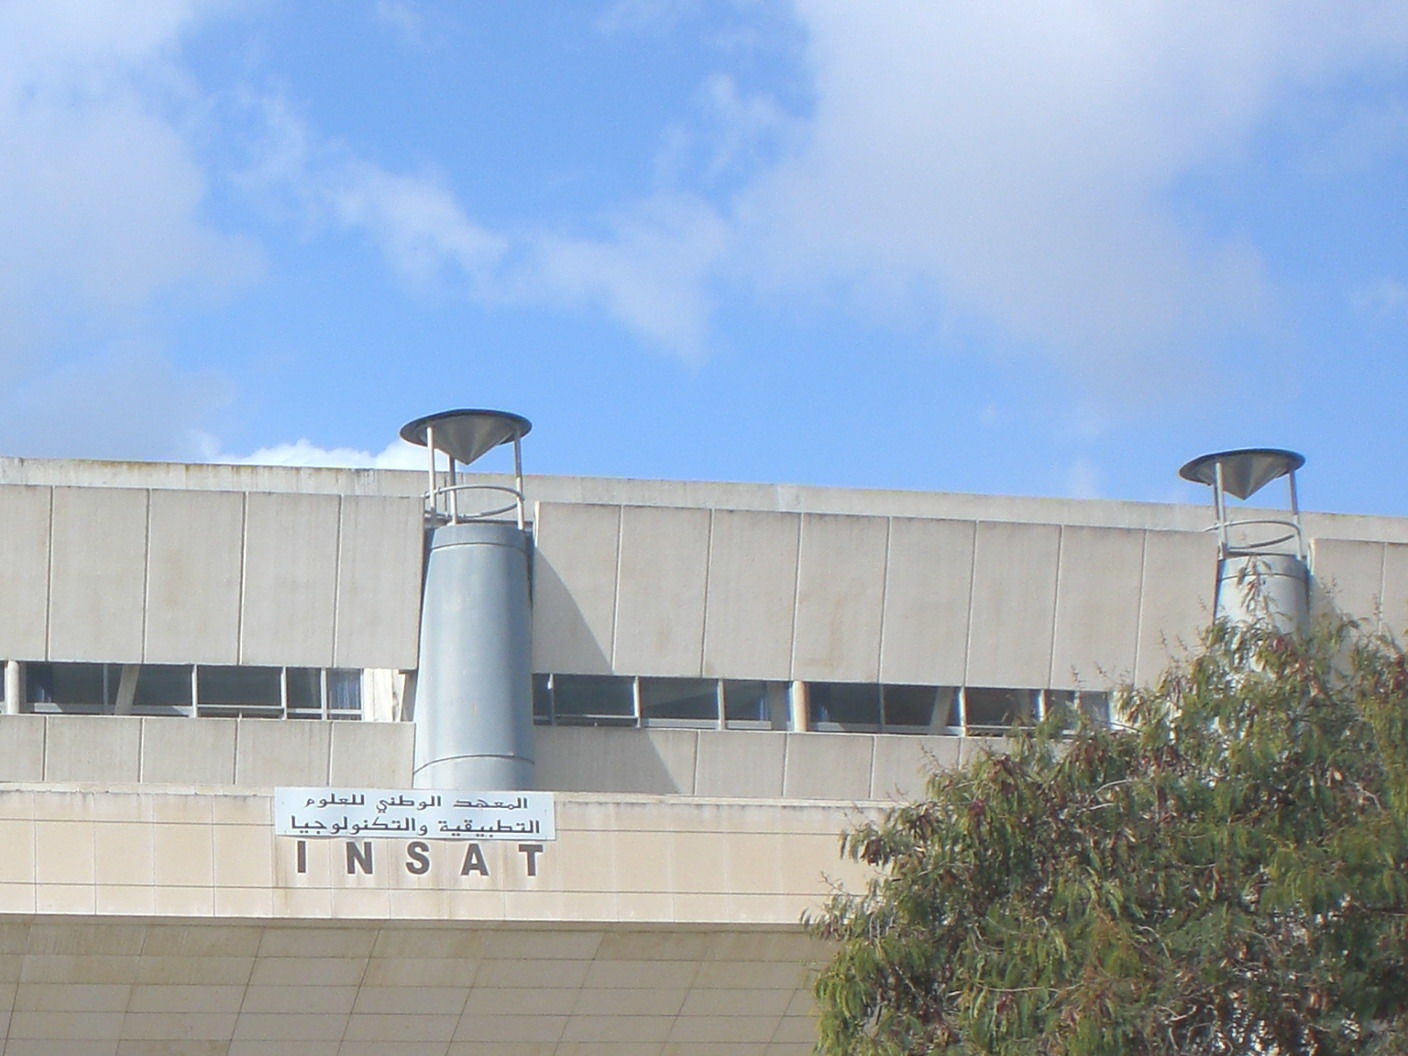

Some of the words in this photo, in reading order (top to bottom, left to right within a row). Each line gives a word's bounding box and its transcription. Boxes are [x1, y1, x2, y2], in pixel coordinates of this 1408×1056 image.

[304, 792, 366, 808] للعلوم
[375, 794, 441, 814] الوطني
[453, 797, 528, 810] المعهد
[290, 814, 428, 836] والتكنولوجيا
[437, 819, 540, 838] التطبيقية
[296, 840, 543, 877] INSAT
